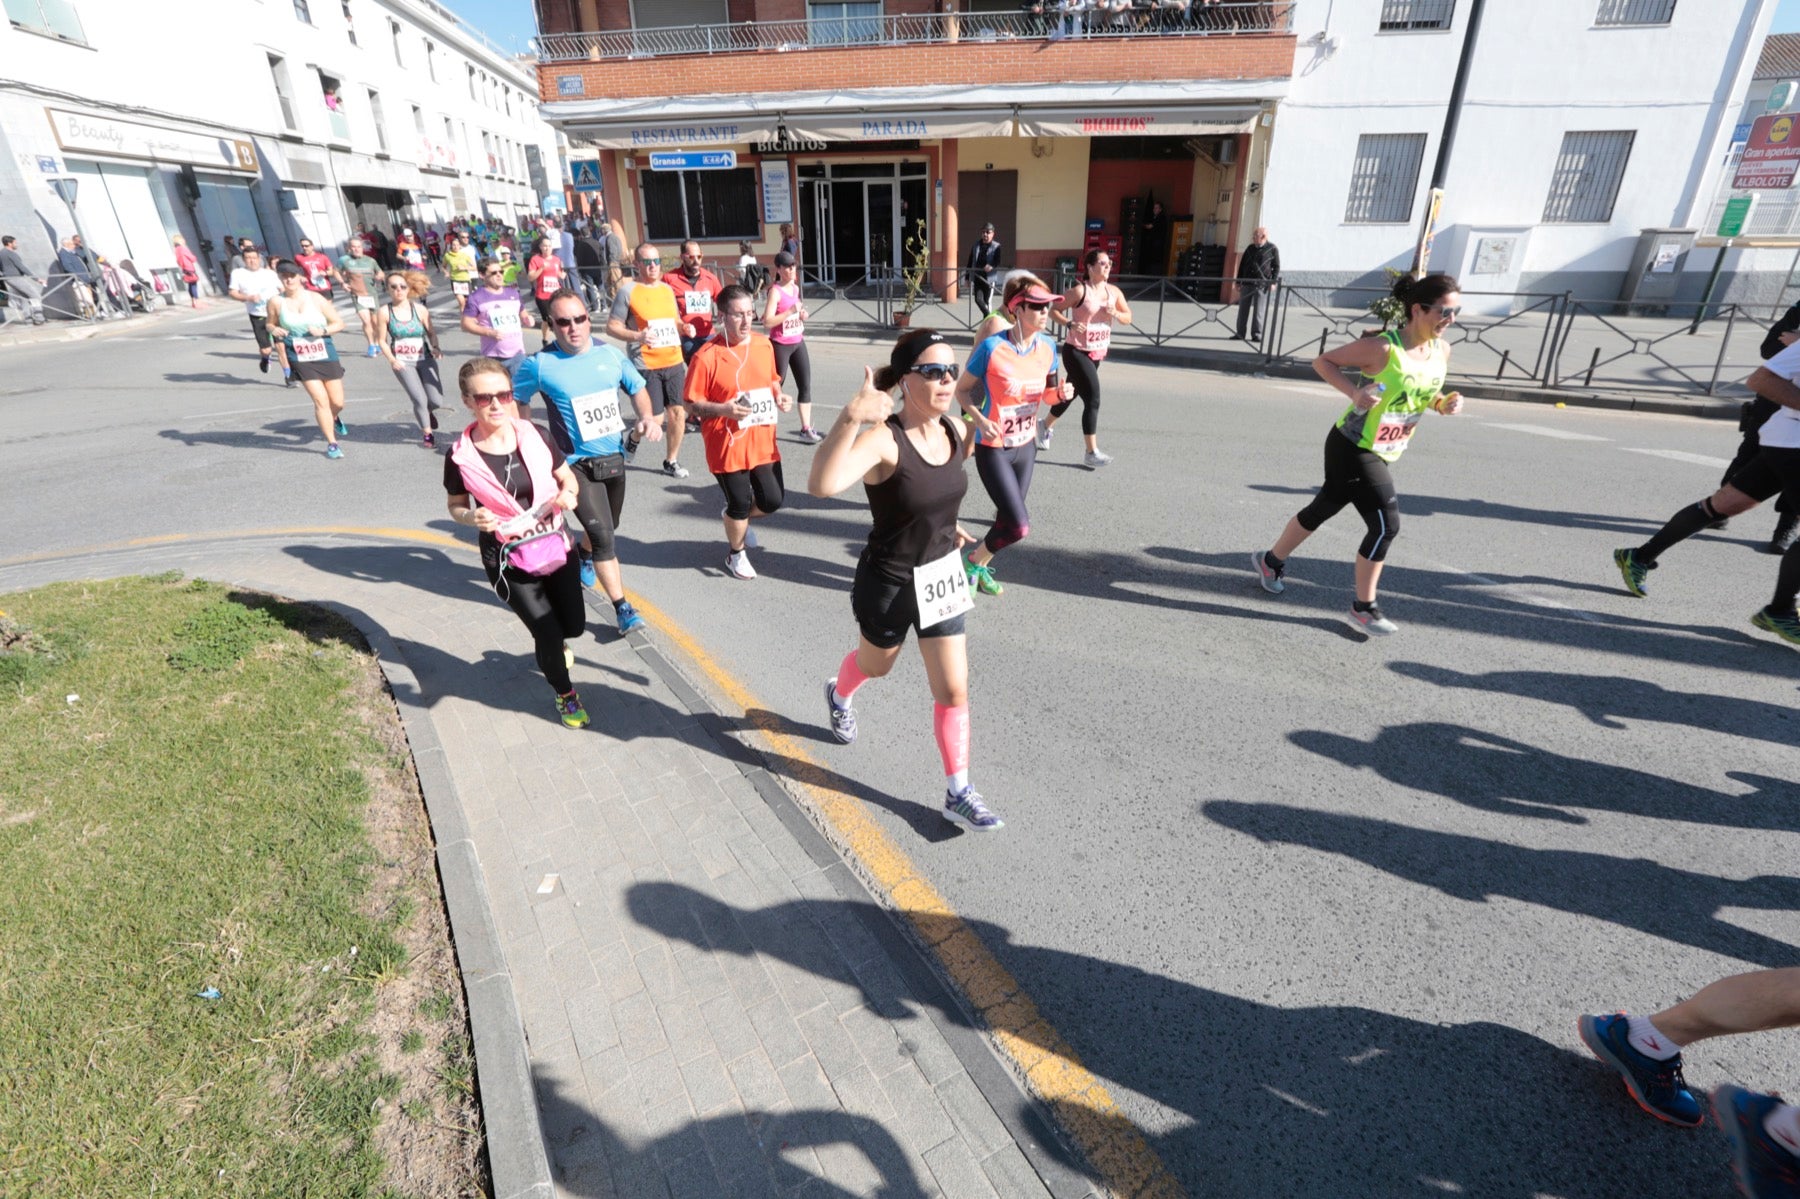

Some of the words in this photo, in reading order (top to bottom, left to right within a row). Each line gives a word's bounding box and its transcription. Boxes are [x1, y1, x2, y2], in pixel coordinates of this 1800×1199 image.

[67, 116, 124, 150] Beauty
[631, 125, 739, 144] RESTAURANTE
[862, 120, 928, 136] PARADA
[240, 145, 253, 166] B
[1744, 147, 1764, 158] Gran
[652, 157, 687, 166] Granada
[1735, 175, 1790, 187] ALBOLOTE
[653, 326, 676, 338] 3174
[296, 343, 324, 355] 2198
[583, 402, 617, 425] 3036
[751, 399, 773, 415] 037
[924, 570, 965, 604] 3014
